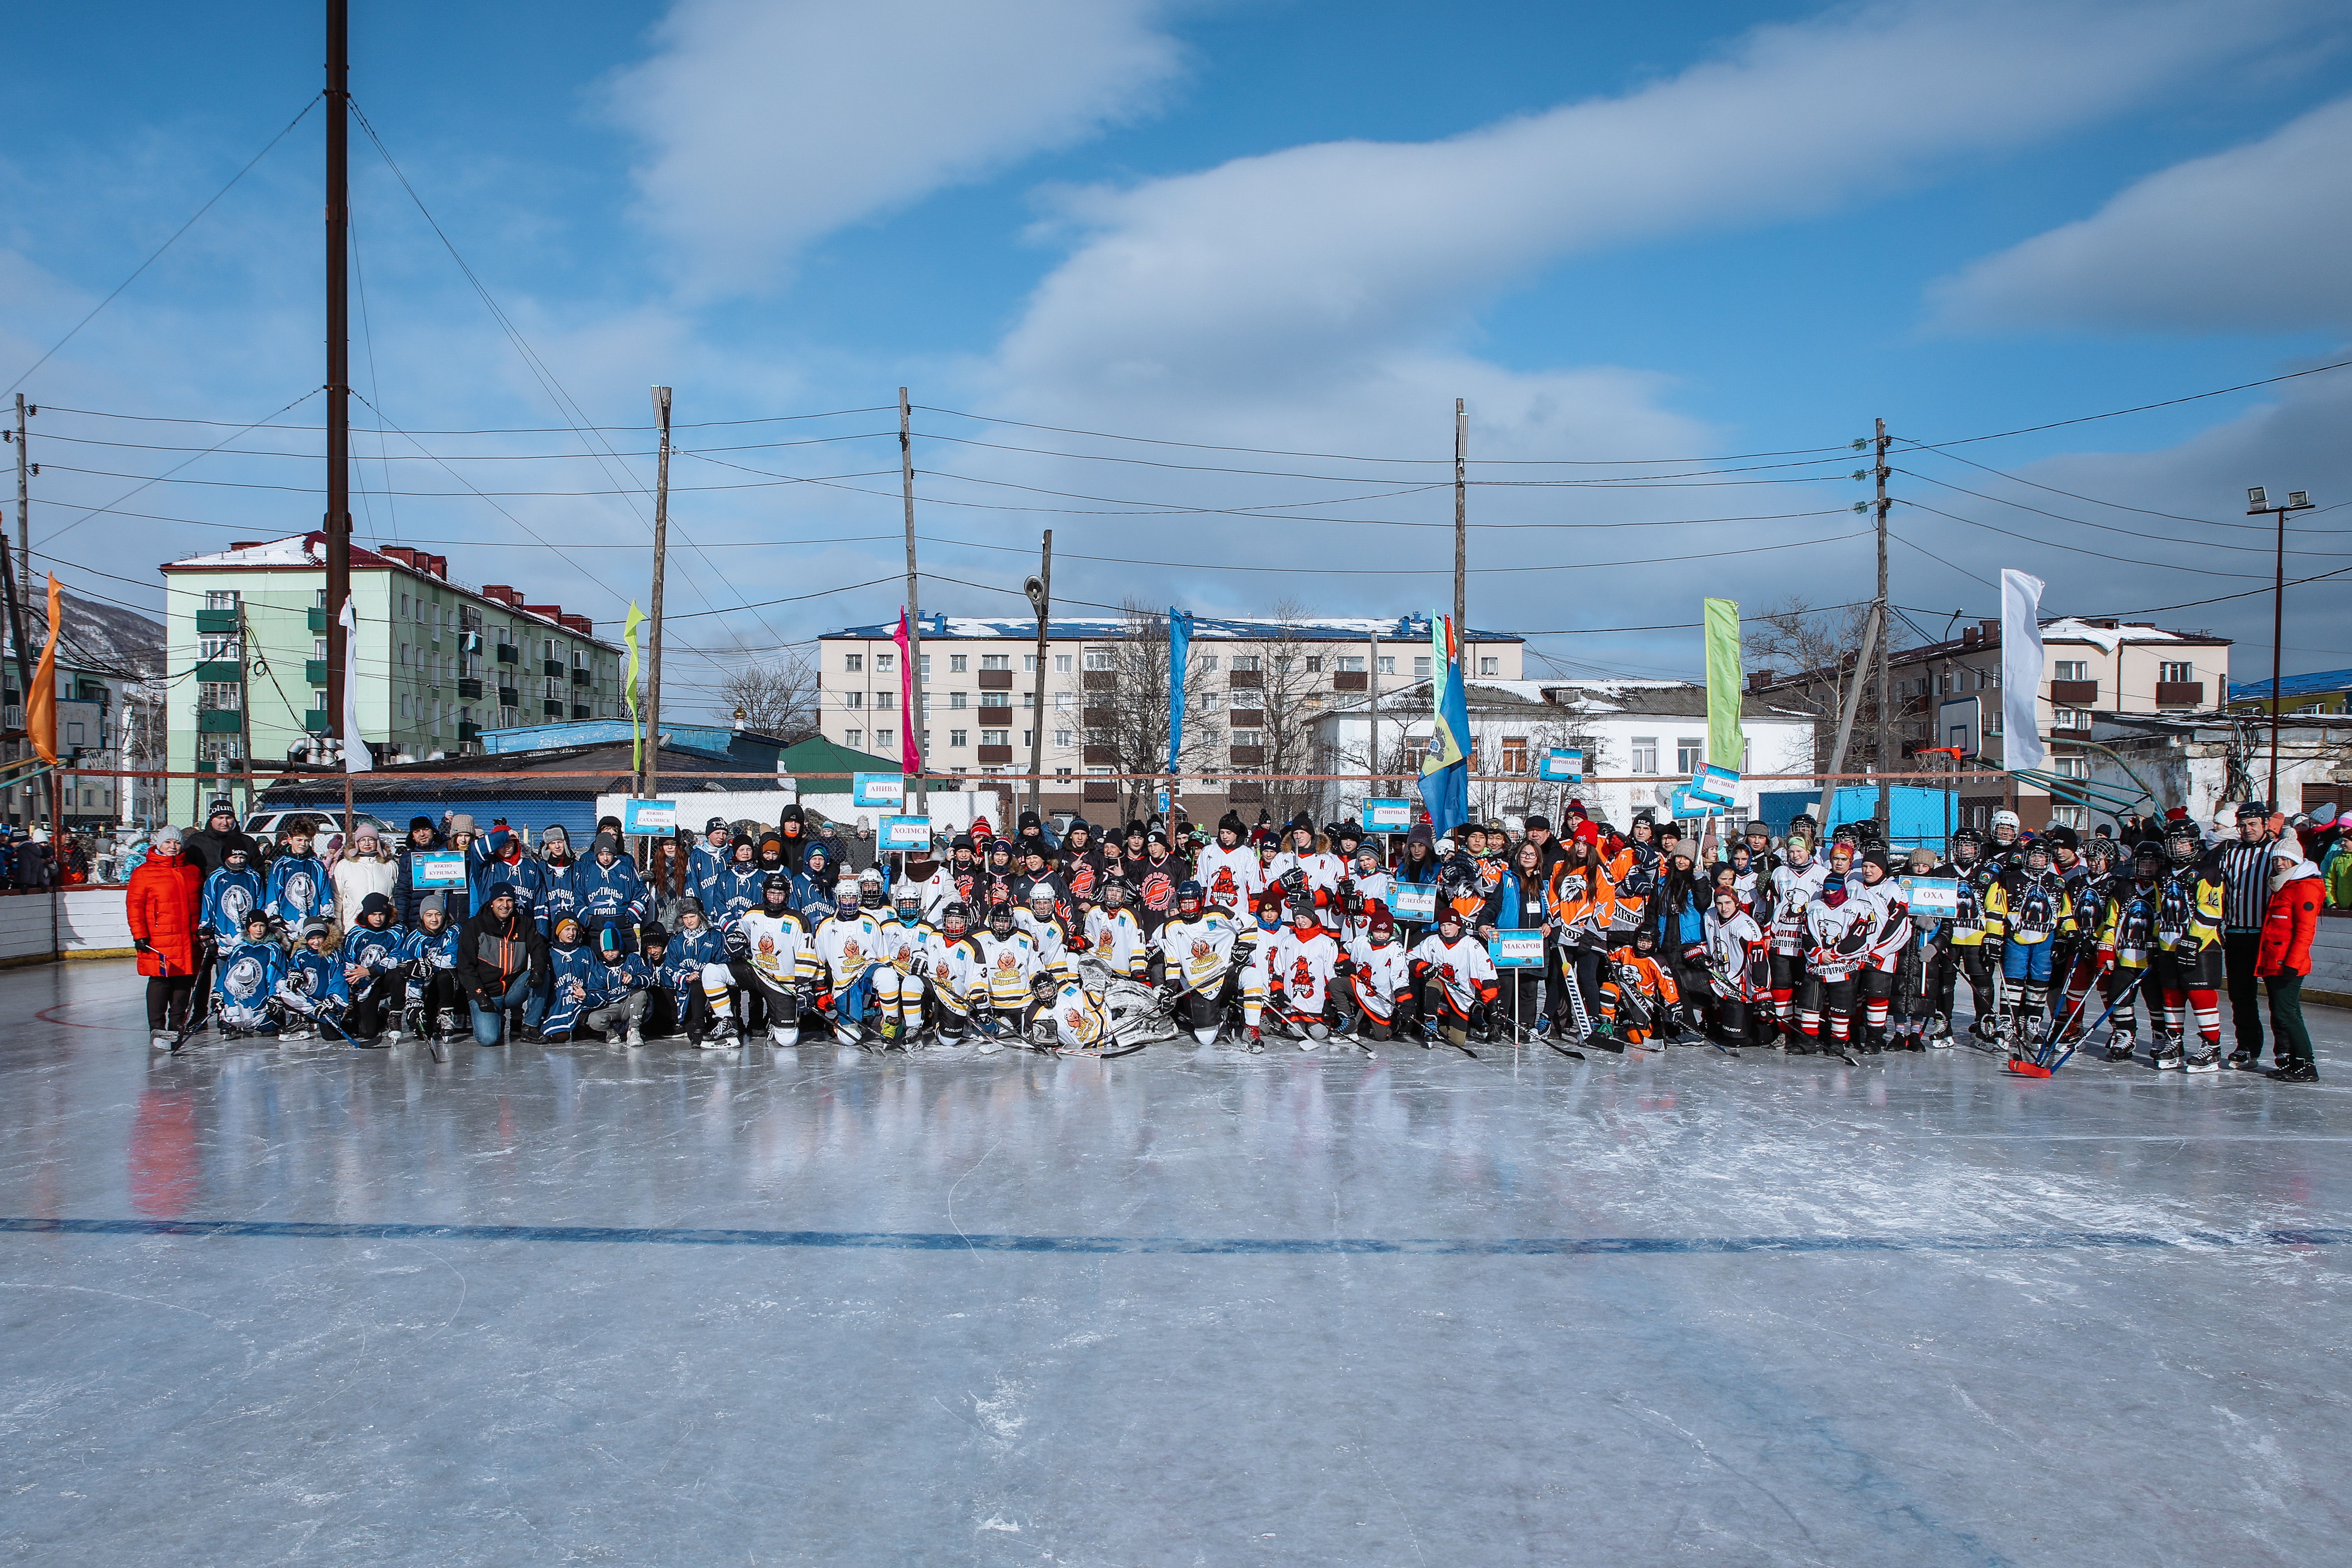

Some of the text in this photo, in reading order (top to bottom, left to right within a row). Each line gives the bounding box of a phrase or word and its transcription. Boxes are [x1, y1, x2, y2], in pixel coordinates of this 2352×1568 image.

[1707, 777, 1736, 789] НОГЛИКИ
[1398, 896, 1433, 905] УГЛЕГОРСК
[1923, 891, 1944, 899] ОХА
[1744, 919, 1758, 939] АВЕРС
[1752, 949, 1764, 963] 77
[980, 967, 988, 978] 3
